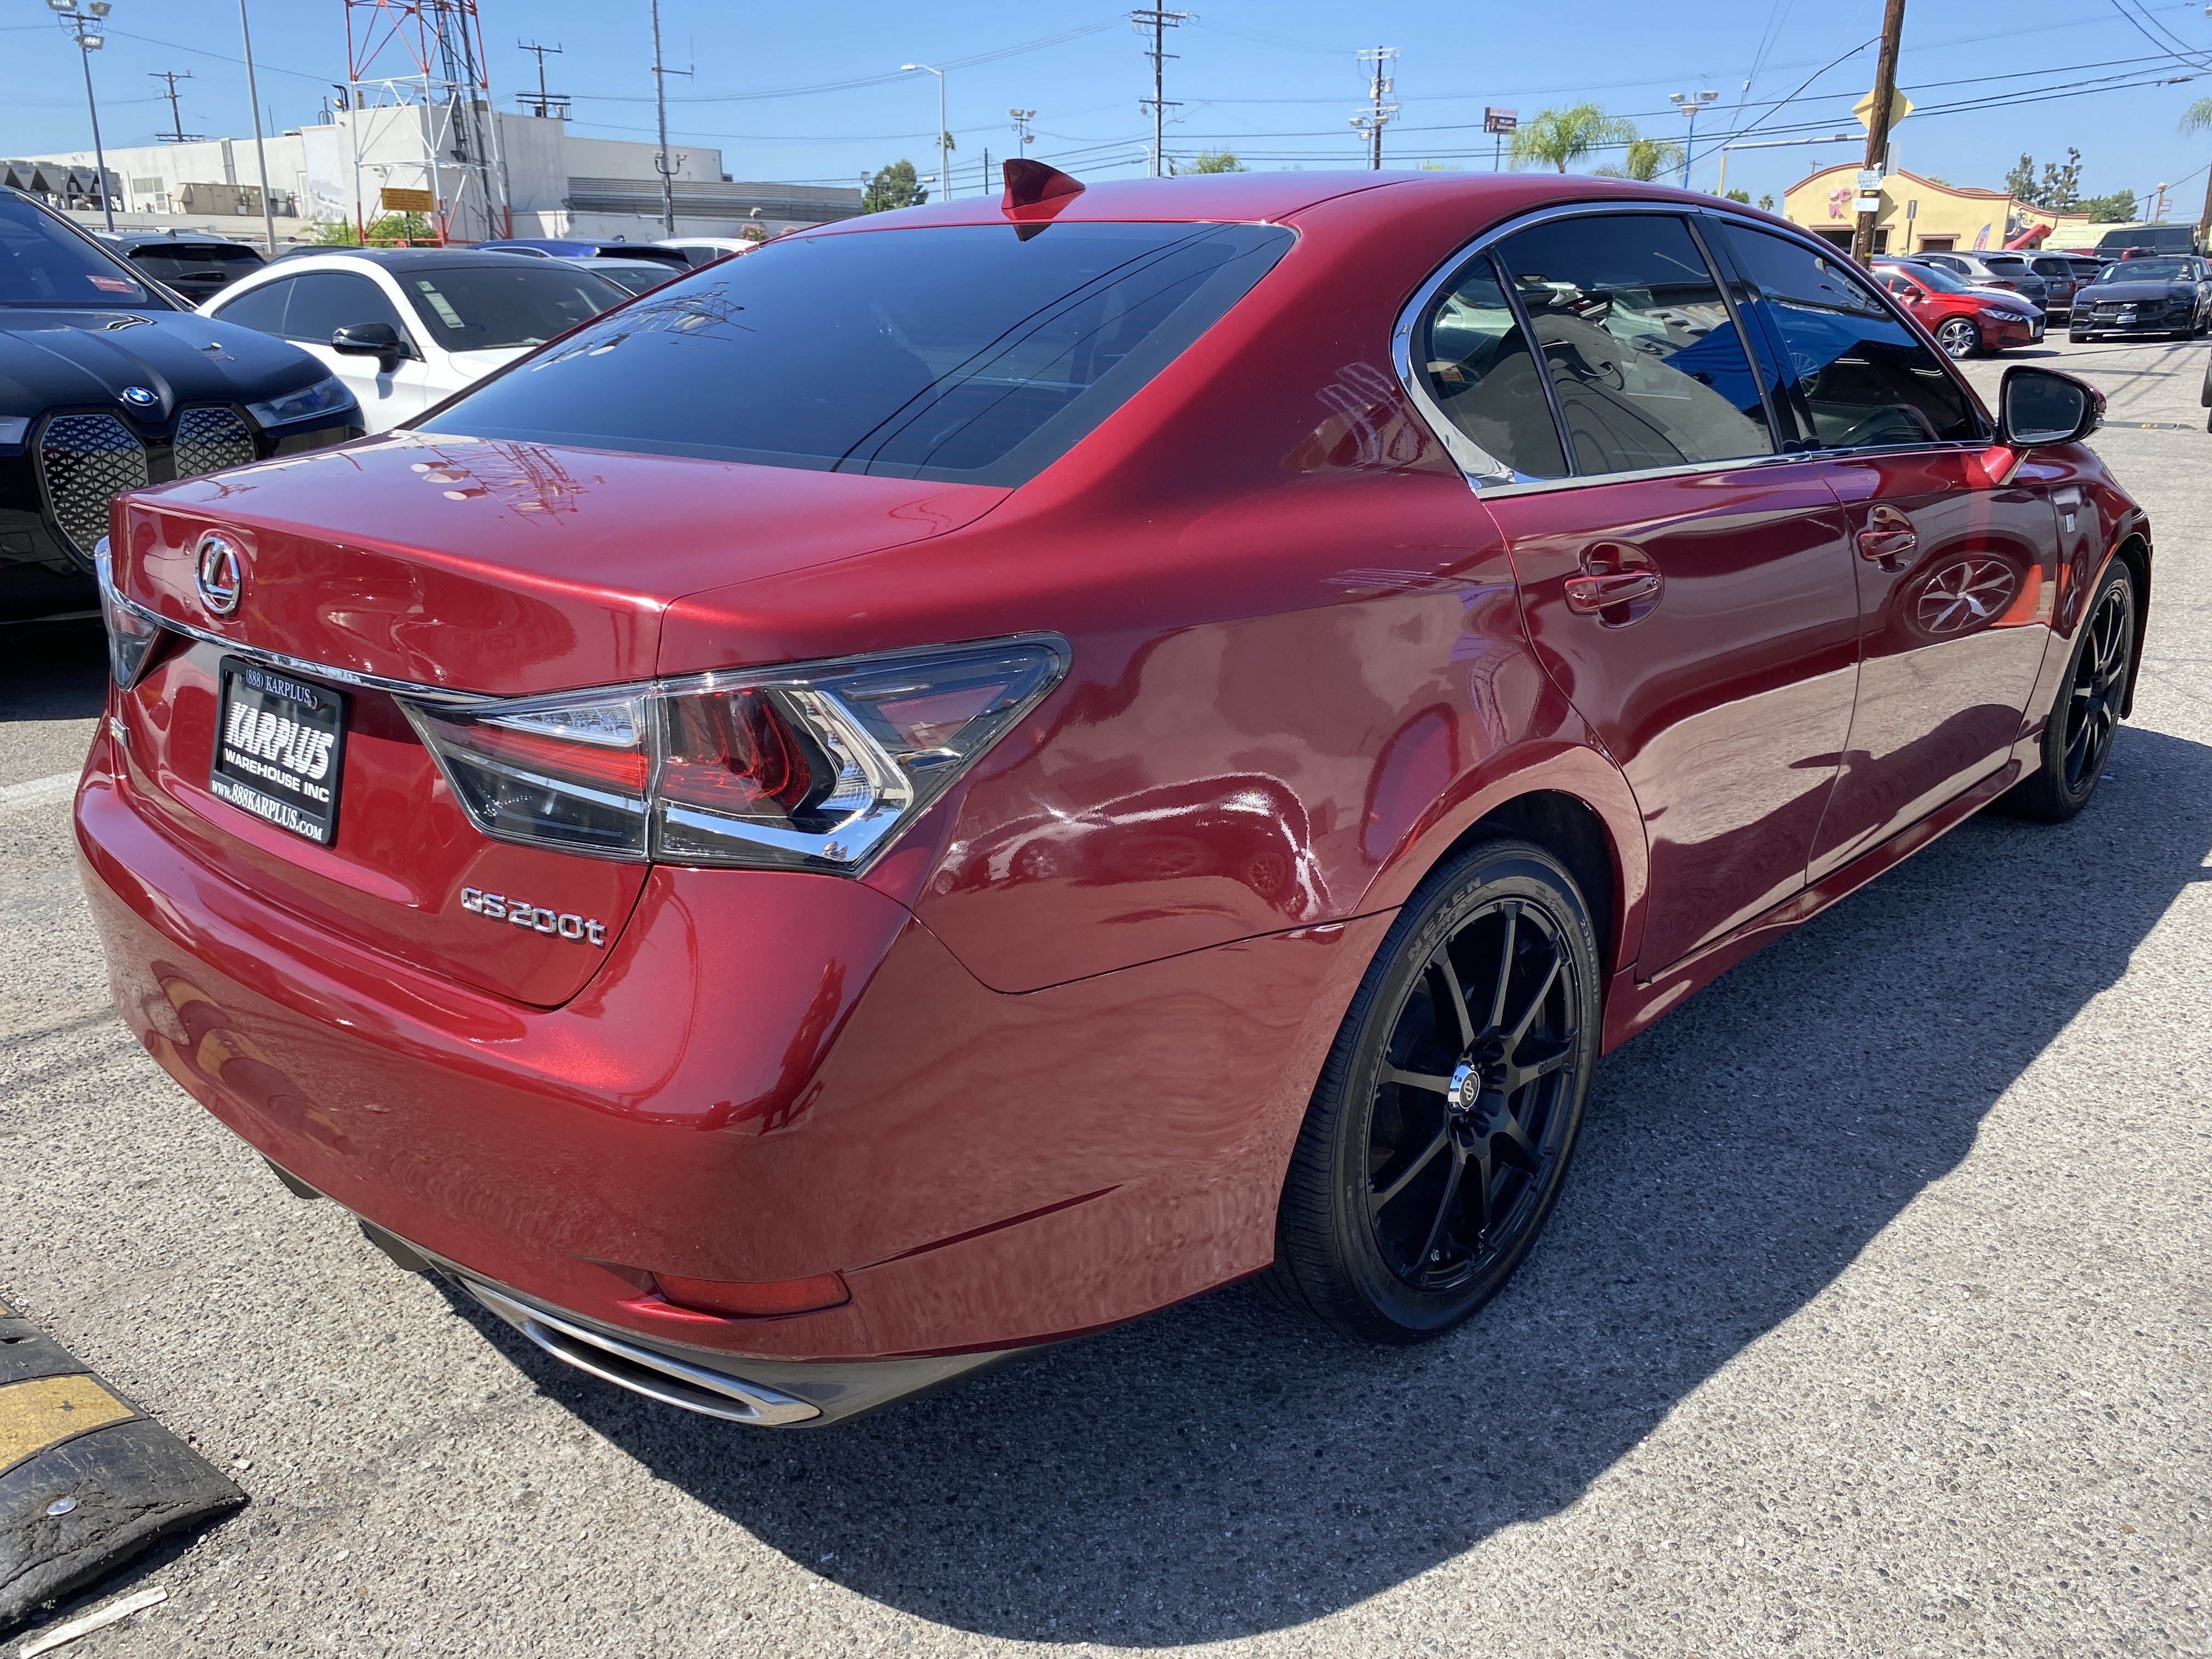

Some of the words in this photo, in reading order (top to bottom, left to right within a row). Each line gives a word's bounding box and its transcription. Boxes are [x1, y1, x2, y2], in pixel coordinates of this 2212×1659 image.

[245, 668, 264, 689] (888)
[266, 675, 312, 704] KARPLUS
[224, 701, 335, 780] KARPLUS
[225, 748, 301, 792] WAREHOUSE
[303, 781, 330, 803] INC
[1407, 876, 1481, 962] NEXEN
